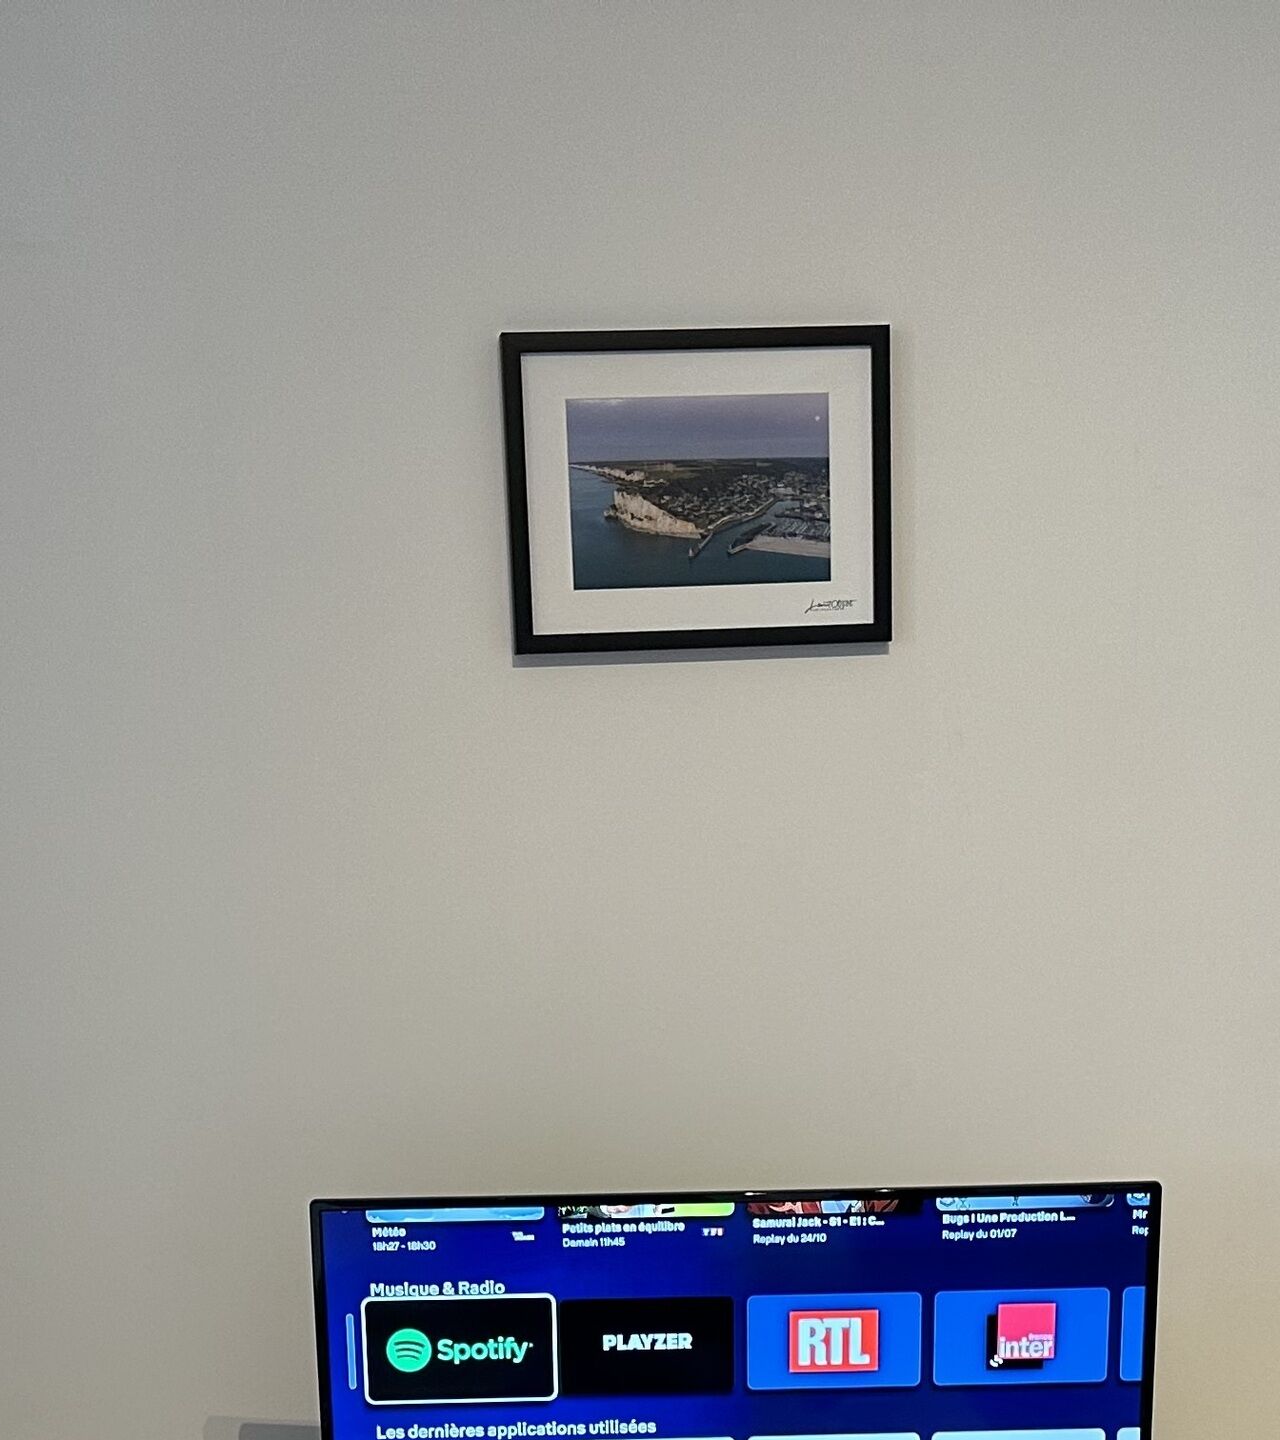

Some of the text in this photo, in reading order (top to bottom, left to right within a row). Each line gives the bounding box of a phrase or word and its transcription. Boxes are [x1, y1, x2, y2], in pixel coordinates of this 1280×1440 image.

[752, 1216, 796, 1228] Samurai
[797, 1216, 821, 1227] Jack
[1000, 1211, 1058, 1223] Production
[372, 1226, 406, 1238] Météo
[562, 1221, 685, 1235] Petits plats en équilibre
[942, 1228, 1017, 1241] Replay du 01/07
[562, 1237, 598, 1247] Demain
[753, 1233, 827, 1245] Replay du 24/10
[370, 1280, 506, 1297] Musique & Radio
[602, 1332, 693, 1351] PLAYZER
[797, 1317, 870, 1367] RTL
[999, 1336, 1053, 1358] inter
[437, 1336, 531, 1364] Spotify
[376, 1419, 657, 1440] Les dernières applications utilisées
